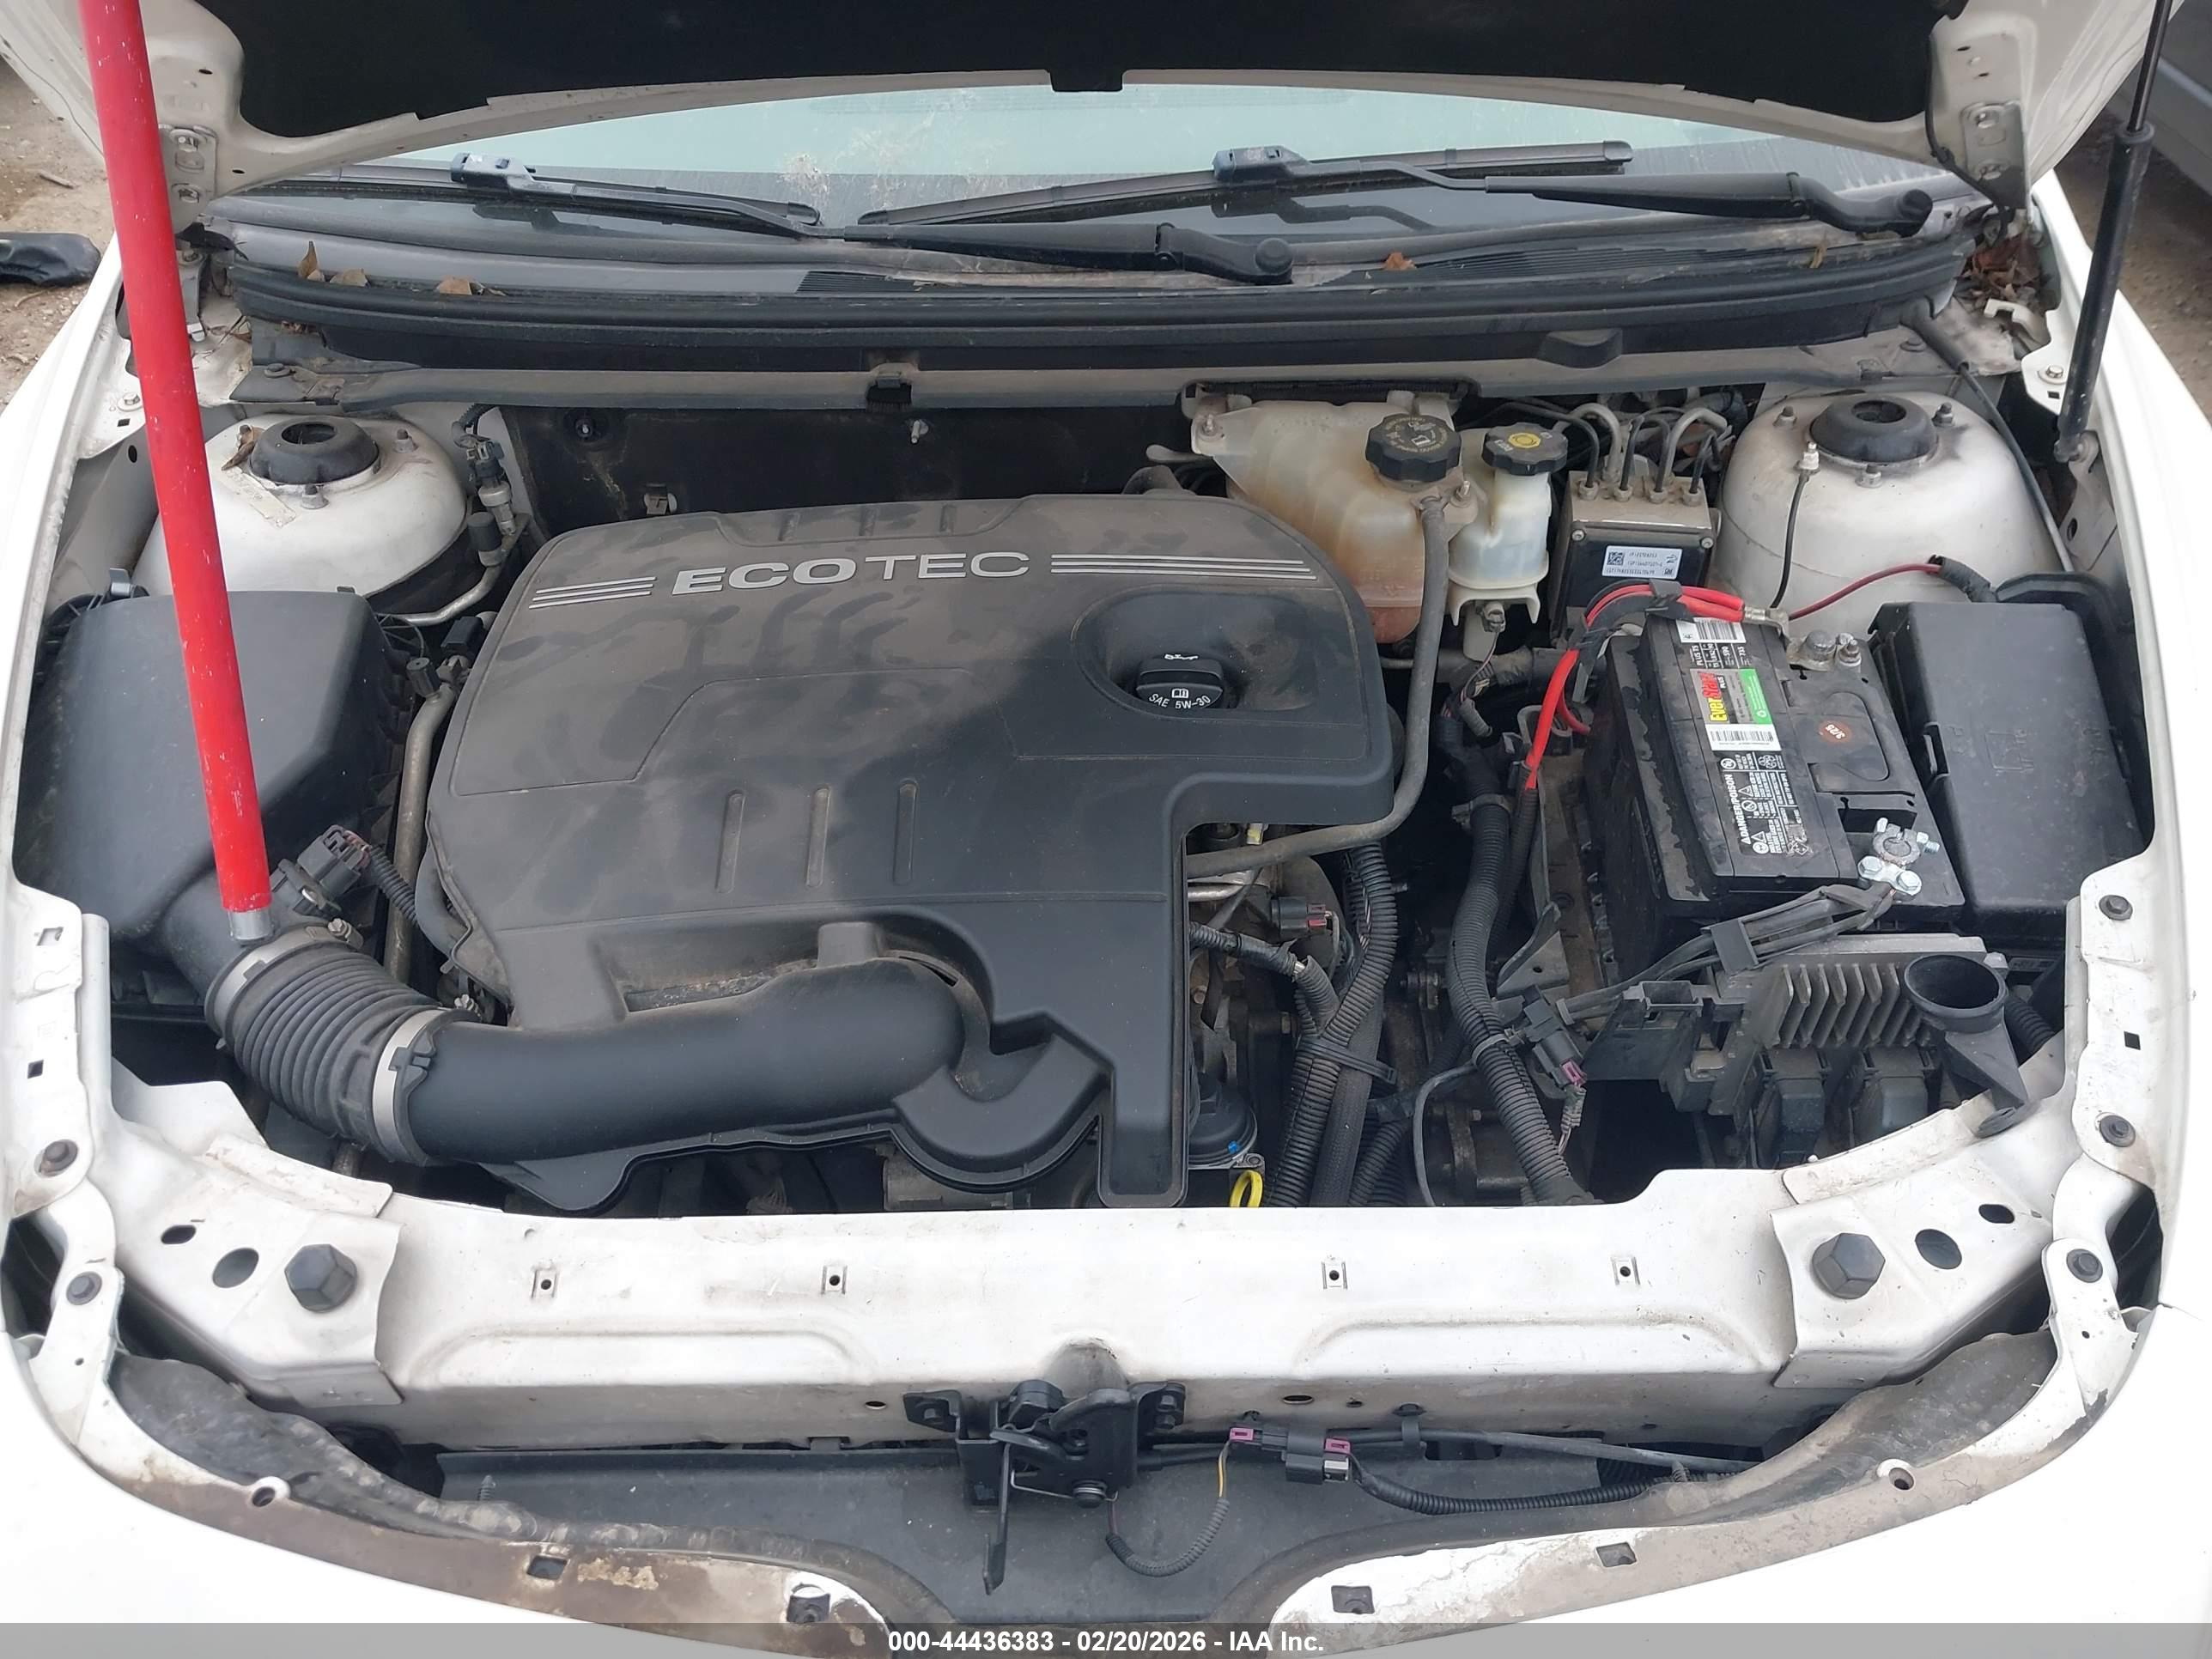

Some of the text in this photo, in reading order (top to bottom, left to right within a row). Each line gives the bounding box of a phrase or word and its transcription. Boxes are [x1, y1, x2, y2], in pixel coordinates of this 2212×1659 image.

[672, 551, 1030, 595] ECOTEC
[1717, 677, 1726, 689] PLUS
[1148, 693, 1211, 709] SAE 5W-30
[1724, 774, 1749, 837] DANGER/POISON
